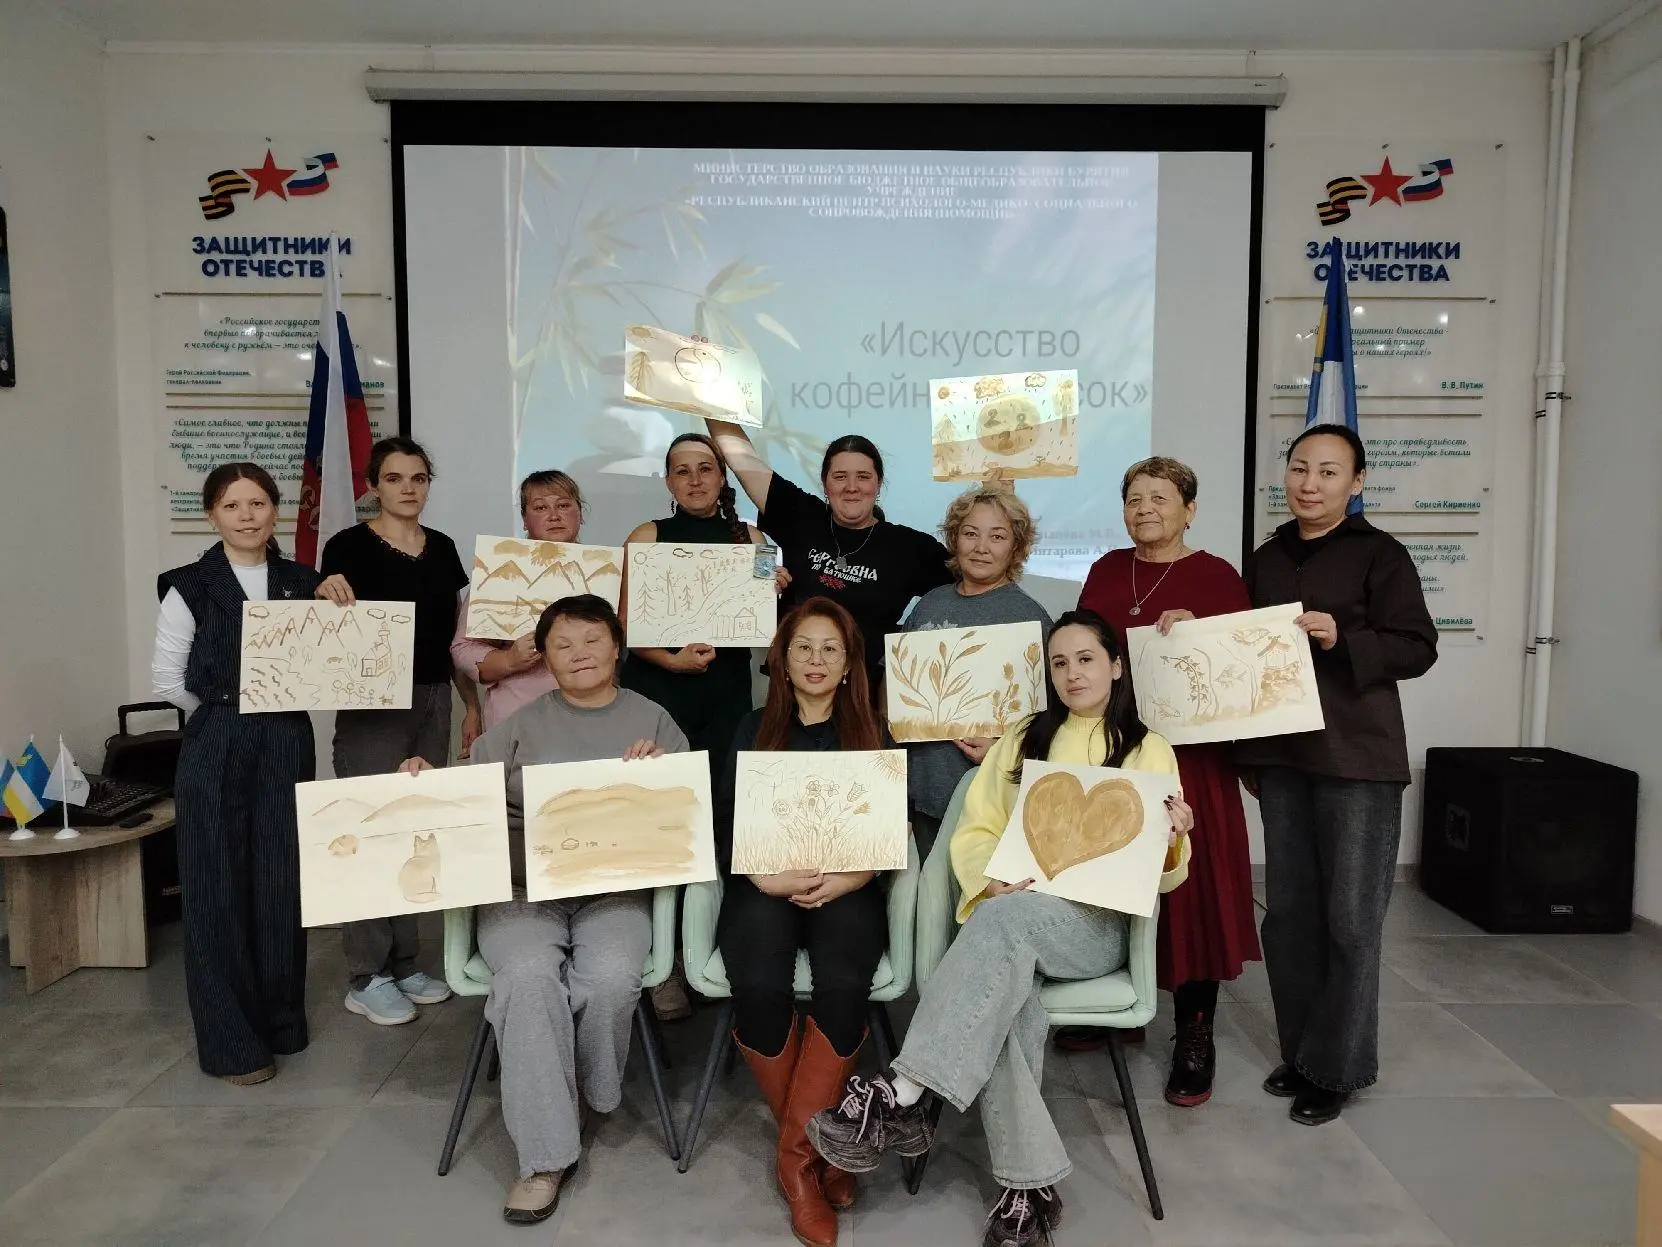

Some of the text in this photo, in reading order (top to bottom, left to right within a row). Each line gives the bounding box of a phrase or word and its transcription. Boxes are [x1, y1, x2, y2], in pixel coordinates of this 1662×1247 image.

[201, 258, 327, 278] ОТЕЧЕСТВ
[1314, 264, 1450, 282] ОЕЧЕСТВА
[274, 319, 320, 329] государст
[860, 320, 1080, 367] «Искусство
[1459, 381, 1484, 390] Путин
[791, 371, 931, 419] кофейн
[1435, 616, 1473, 627] Цивилёва
